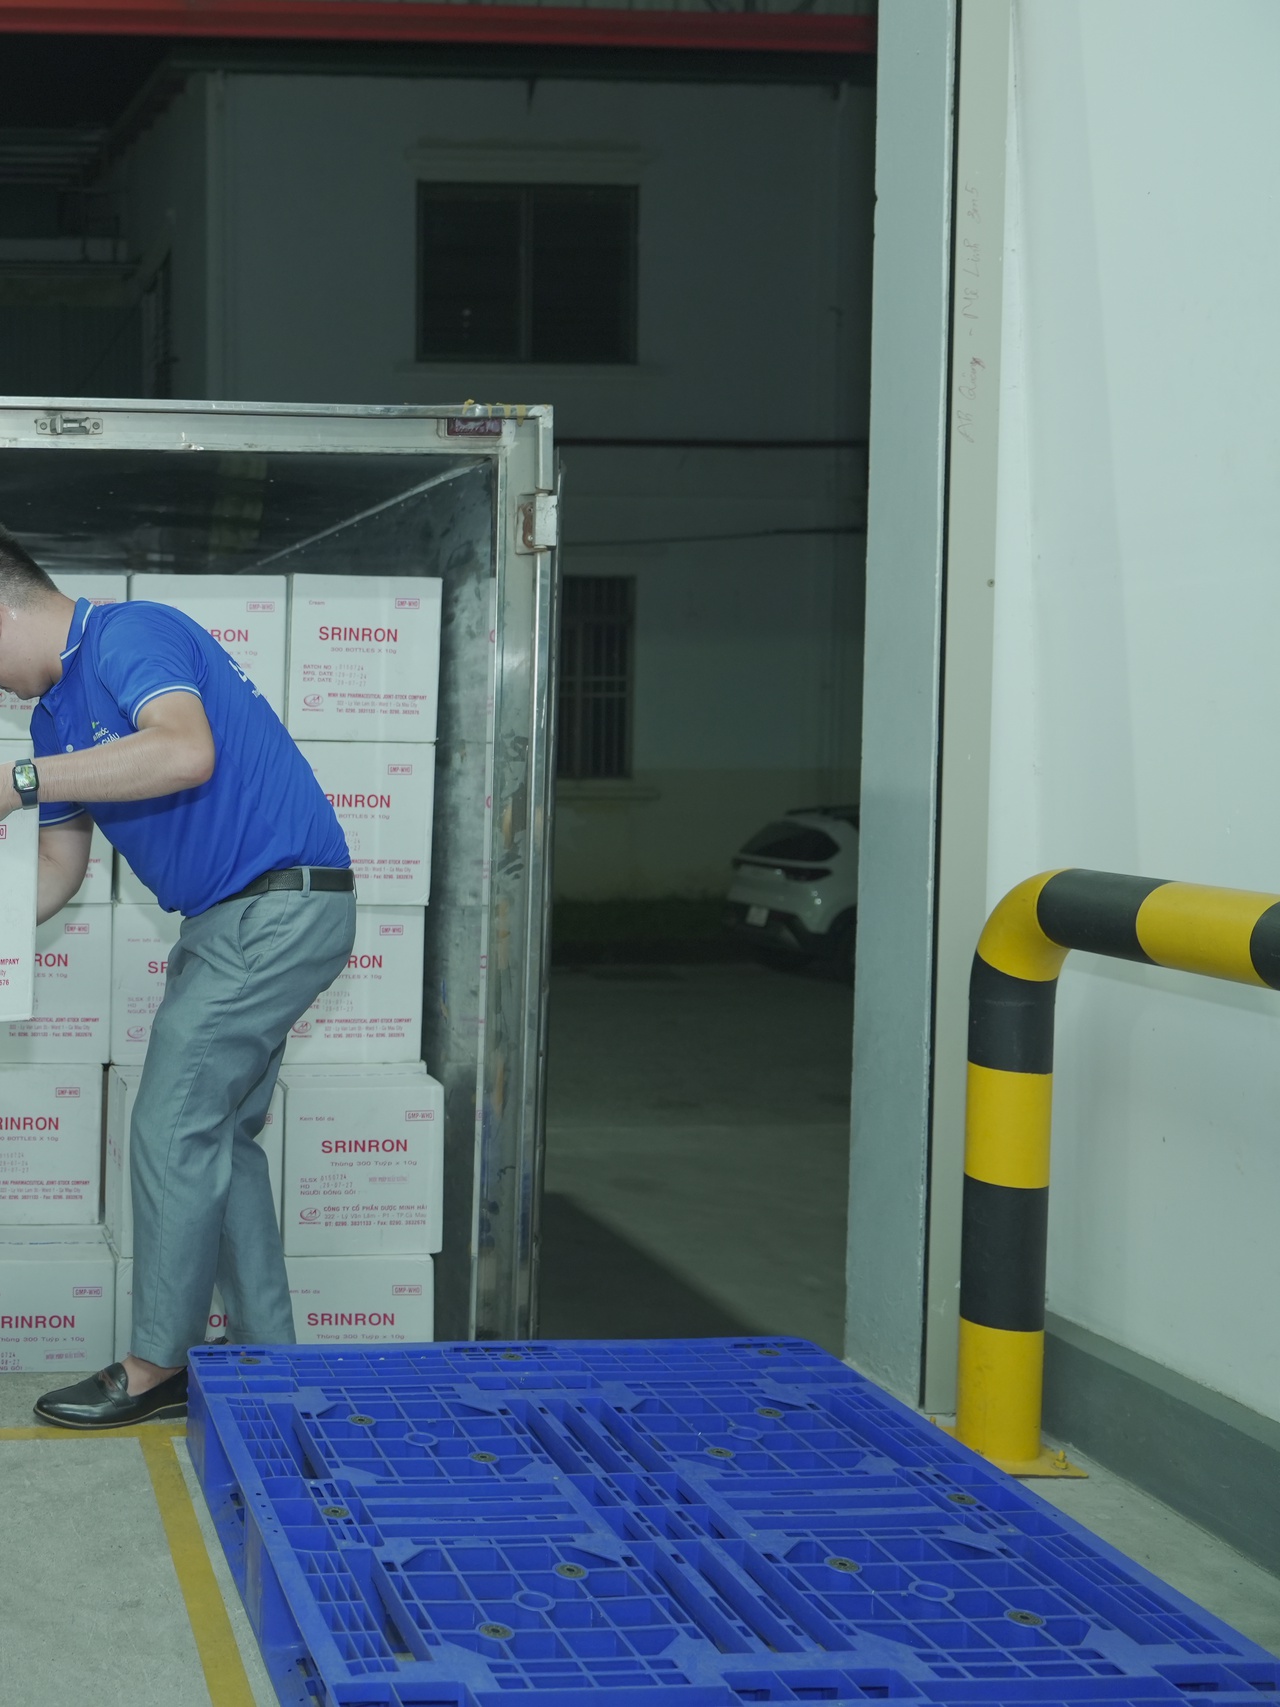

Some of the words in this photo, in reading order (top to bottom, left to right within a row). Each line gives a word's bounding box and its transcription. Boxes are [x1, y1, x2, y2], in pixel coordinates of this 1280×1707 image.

[319, 627, 398, 642] SRINRON
[321, 1139, 408, 1153] SRINRON
[394, 1286, 420, 1294] GMP-WHO
[307, 1313, 395, 1326] SRINRON
